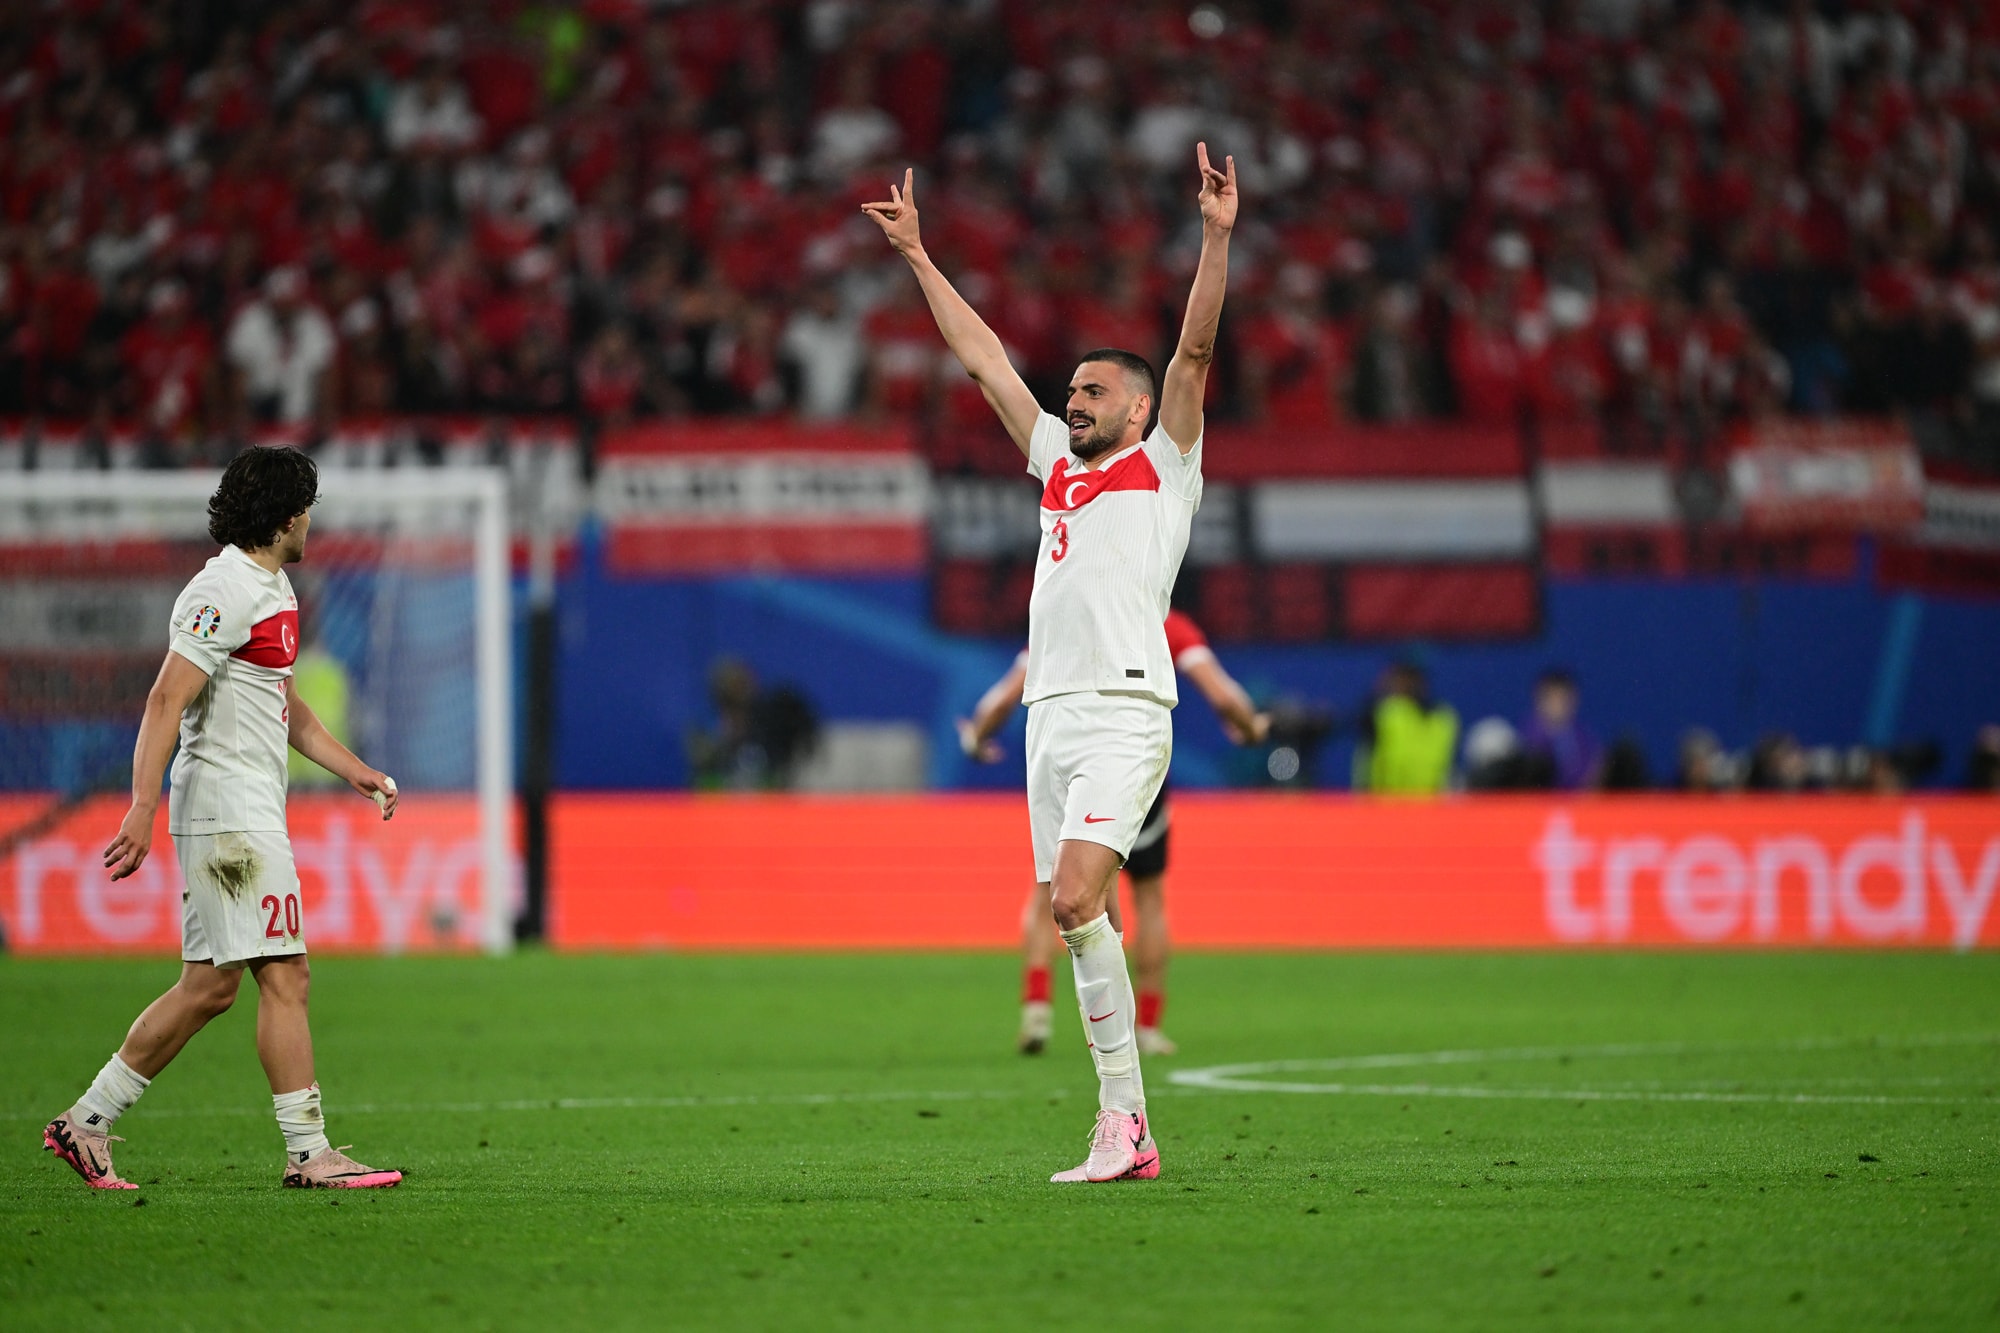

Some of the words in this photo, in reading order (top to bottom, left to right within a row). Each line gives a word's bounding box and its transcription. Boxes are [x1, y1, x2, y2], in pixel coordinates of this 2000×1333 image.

[1051, 522, 1069, 563] 3
[1532, 808, 2000, 953] trendy
[261, 893, 299, 939] 20
